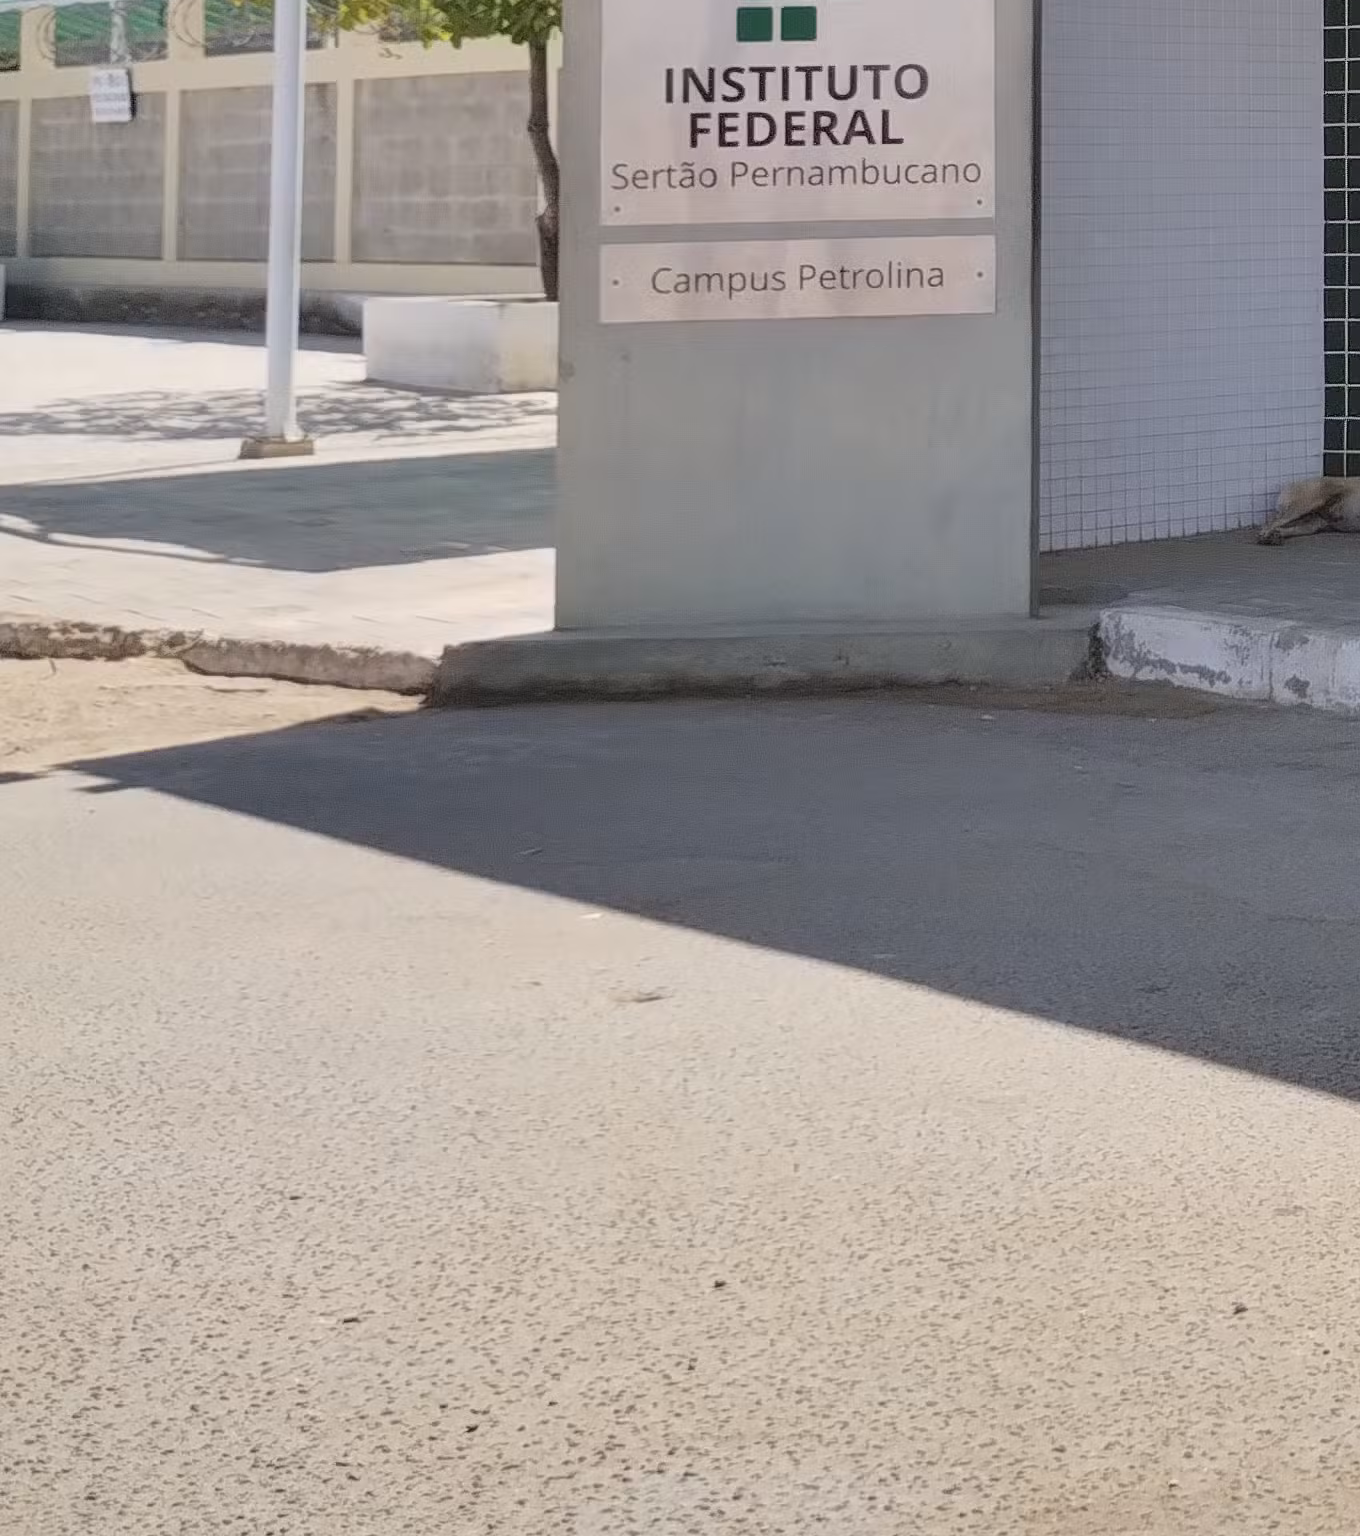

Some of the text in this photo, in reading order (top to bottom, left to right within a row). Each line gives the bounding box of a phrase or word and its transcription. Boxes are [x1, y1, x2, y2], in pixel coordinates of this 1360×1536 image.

[664, 63, 929, 105] INSTITUTO
[689, 108, 905, 149] FEDERAL
[611, 157, 982, 191] Sertão Pernambucano
[650, 260, 944, 301] Campus Petrolina
